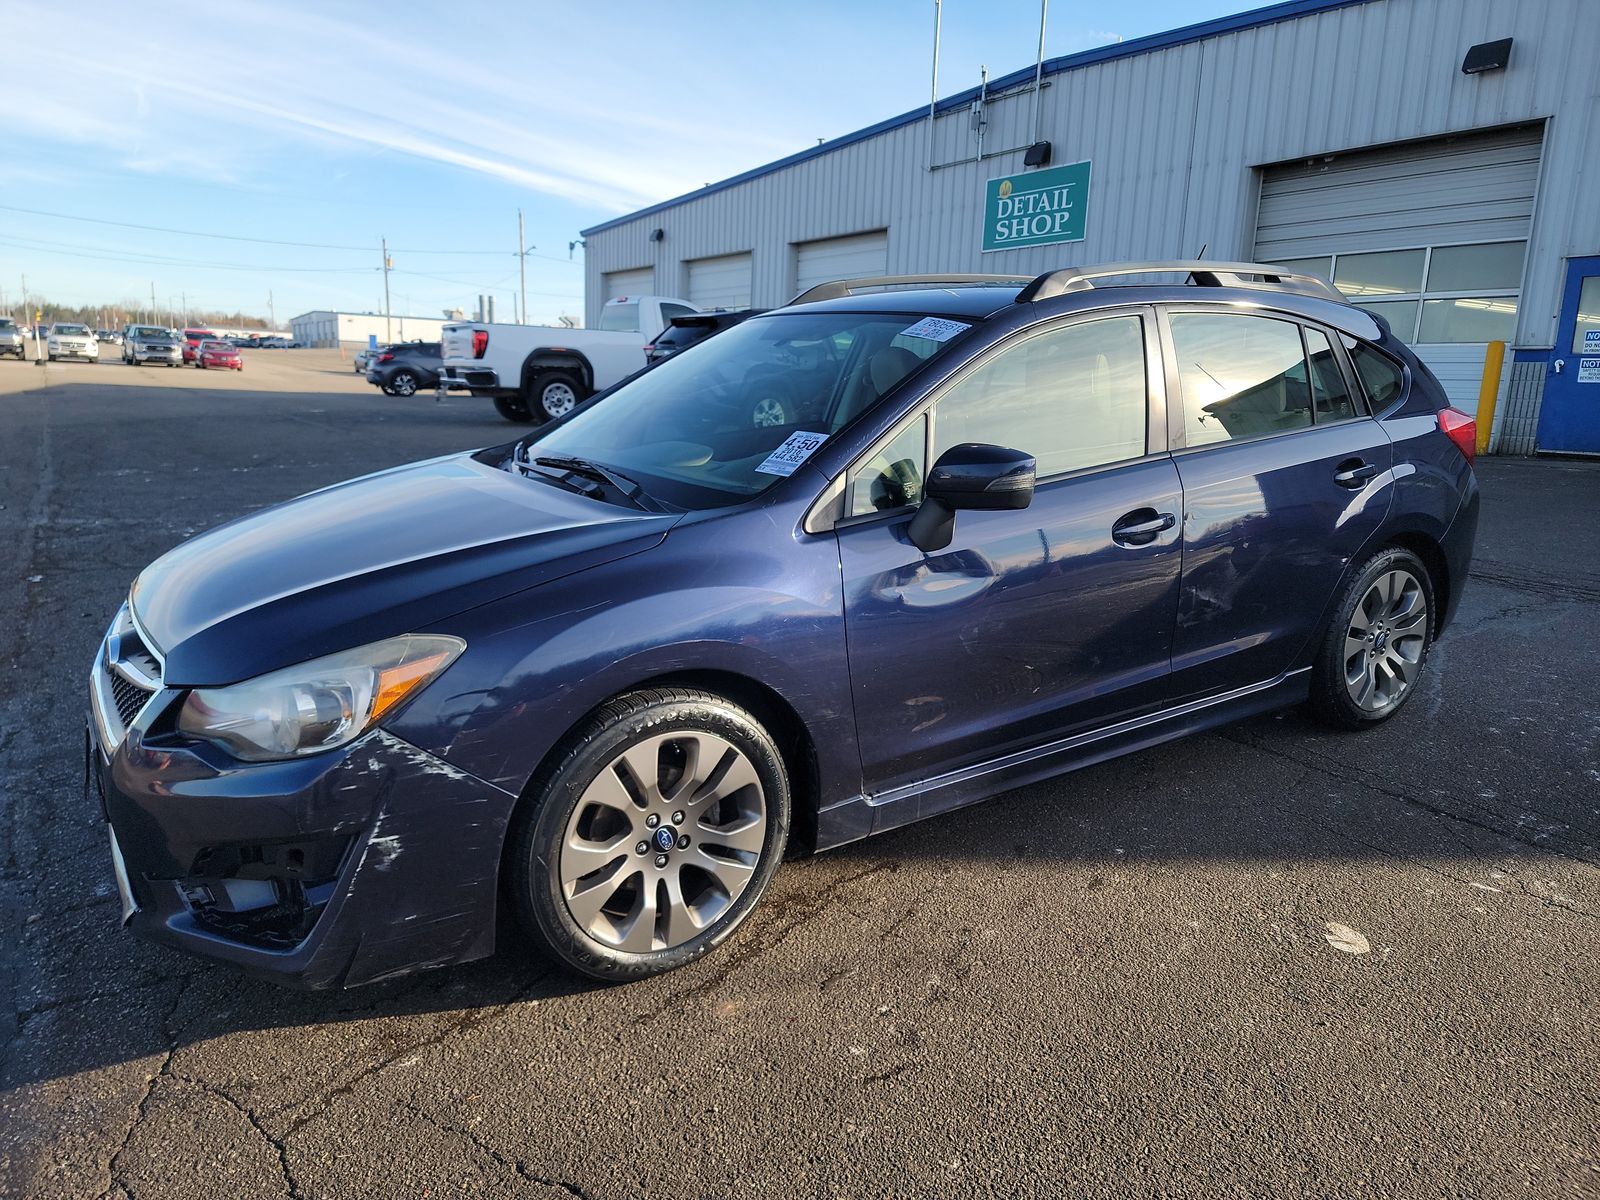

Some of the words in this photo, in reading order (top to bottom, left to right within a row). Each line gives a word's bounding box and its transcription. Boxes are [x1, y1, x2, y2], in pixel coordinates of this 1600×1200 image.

[997, 188, 1073, 219] DETAIL
[995, 211, 1070, 240] SHOP
[782, 446, 804, 455] 2016
